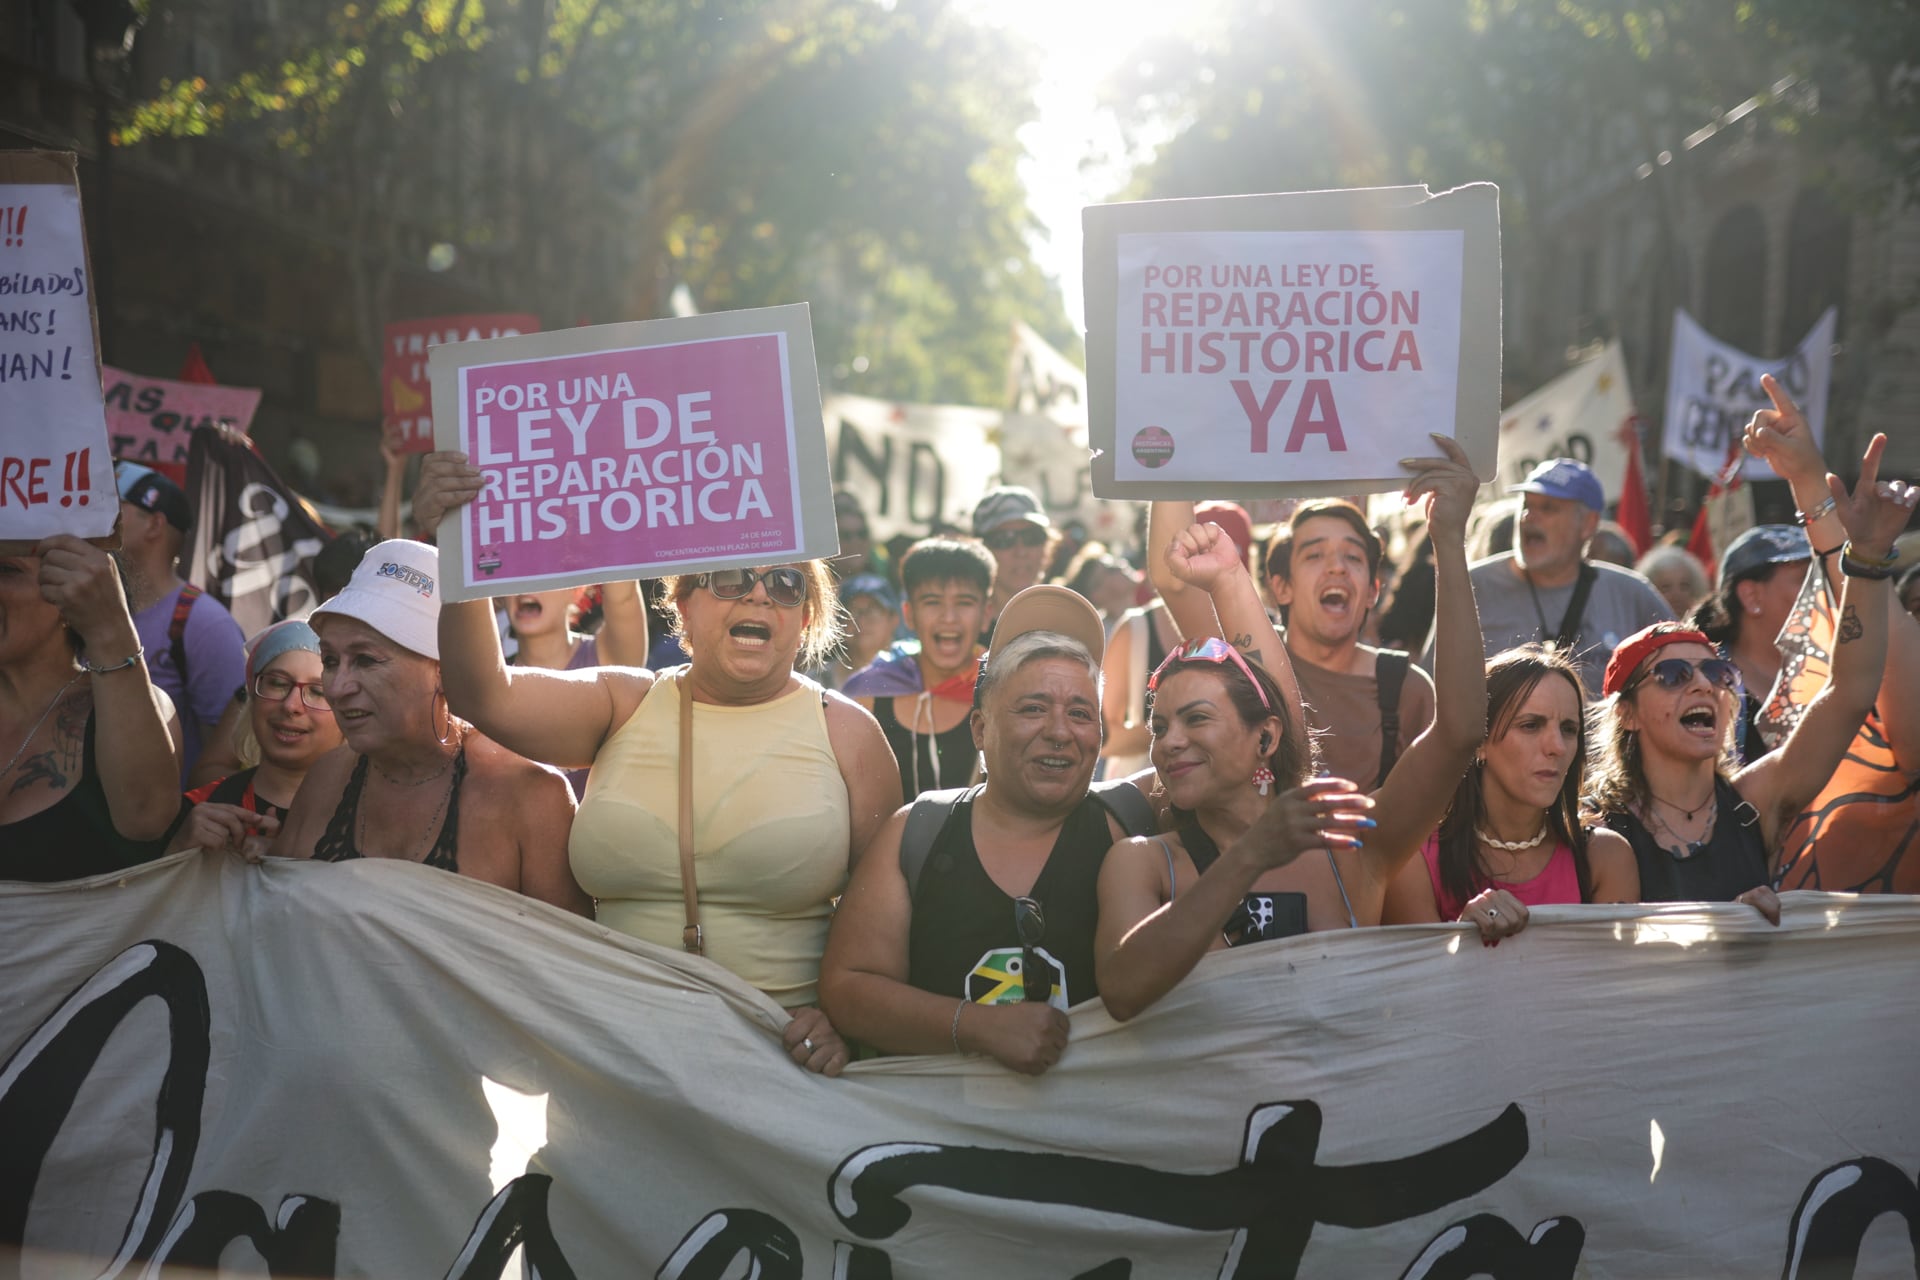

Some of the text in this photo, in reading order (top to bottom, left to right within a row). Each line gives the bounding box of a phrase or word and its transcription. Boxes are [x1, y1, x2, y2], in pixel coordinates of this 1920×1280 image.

[1144, 264, 1374, 288] POR UNA LEY DE
[1141, 283, 1420, 327] REPARACIÓN
[1141, 321, 1423, 374] HISTÓRICA
[475, 372, 636, 414] POR UNA
[1229, 379, 1348, 454] YA
[477, 391, 716, 466] LEY DE
[478, 438, 764, 503] REPARACIÓN
[479, 478, 774, 546] HISTORICA
[750, 531, 760, 539] DE
[761, 529, 782, 538] MAYO
[727, 543, 750, 552] PLAZA
[761, 540, 783, 548] MAYO
